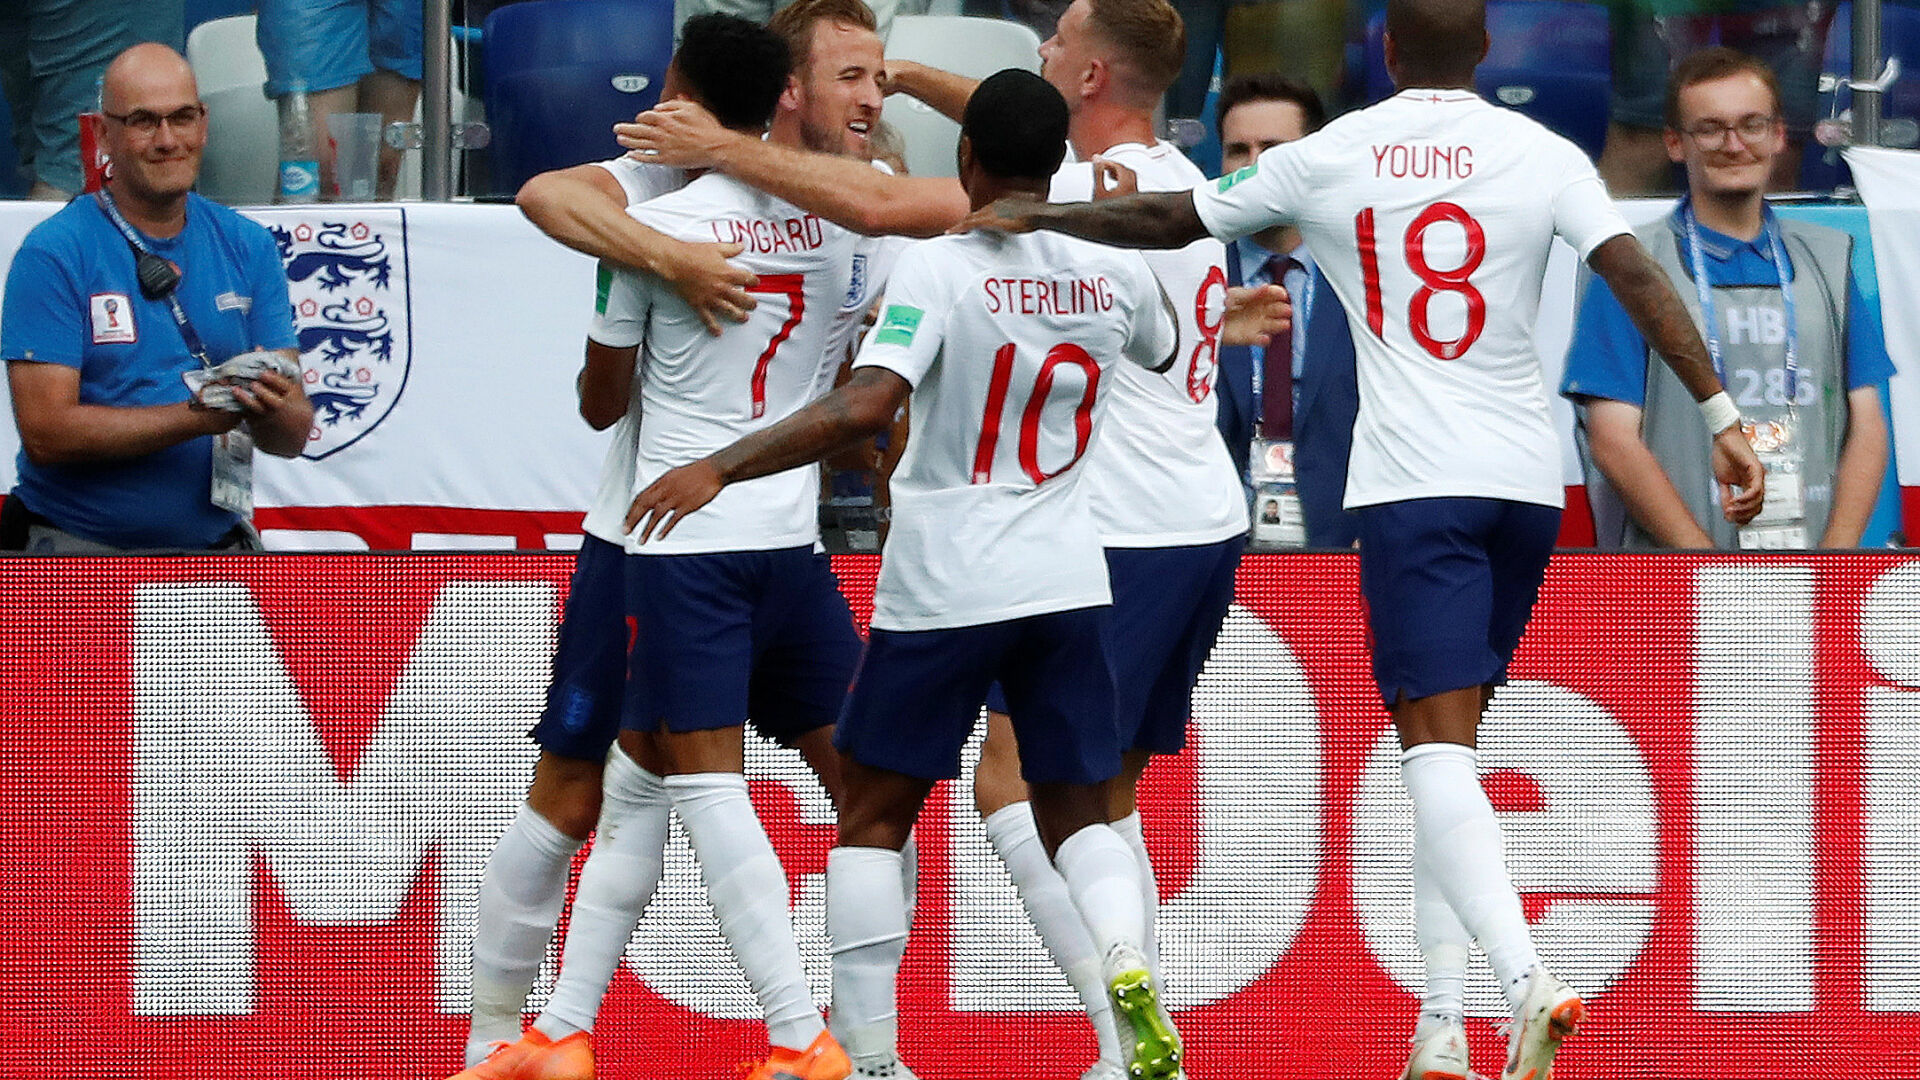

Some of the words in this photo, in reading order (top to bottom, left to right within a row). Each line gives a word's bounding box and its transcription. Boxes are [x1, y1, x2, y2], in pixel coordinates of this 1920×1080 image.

[1371, 144, 1473, 180] YOUNG
[712, 213, 823, 254] LINGARD
[984, 277, 1113, 315] STERLING
[1355, 201, 1486, 361] 18
[1726, 307, 1786, 345] HB
[744, 273, 805, 420] 7
[1186, 265, 1228, 404] 8
[972, 342, 1101, 485] 10
